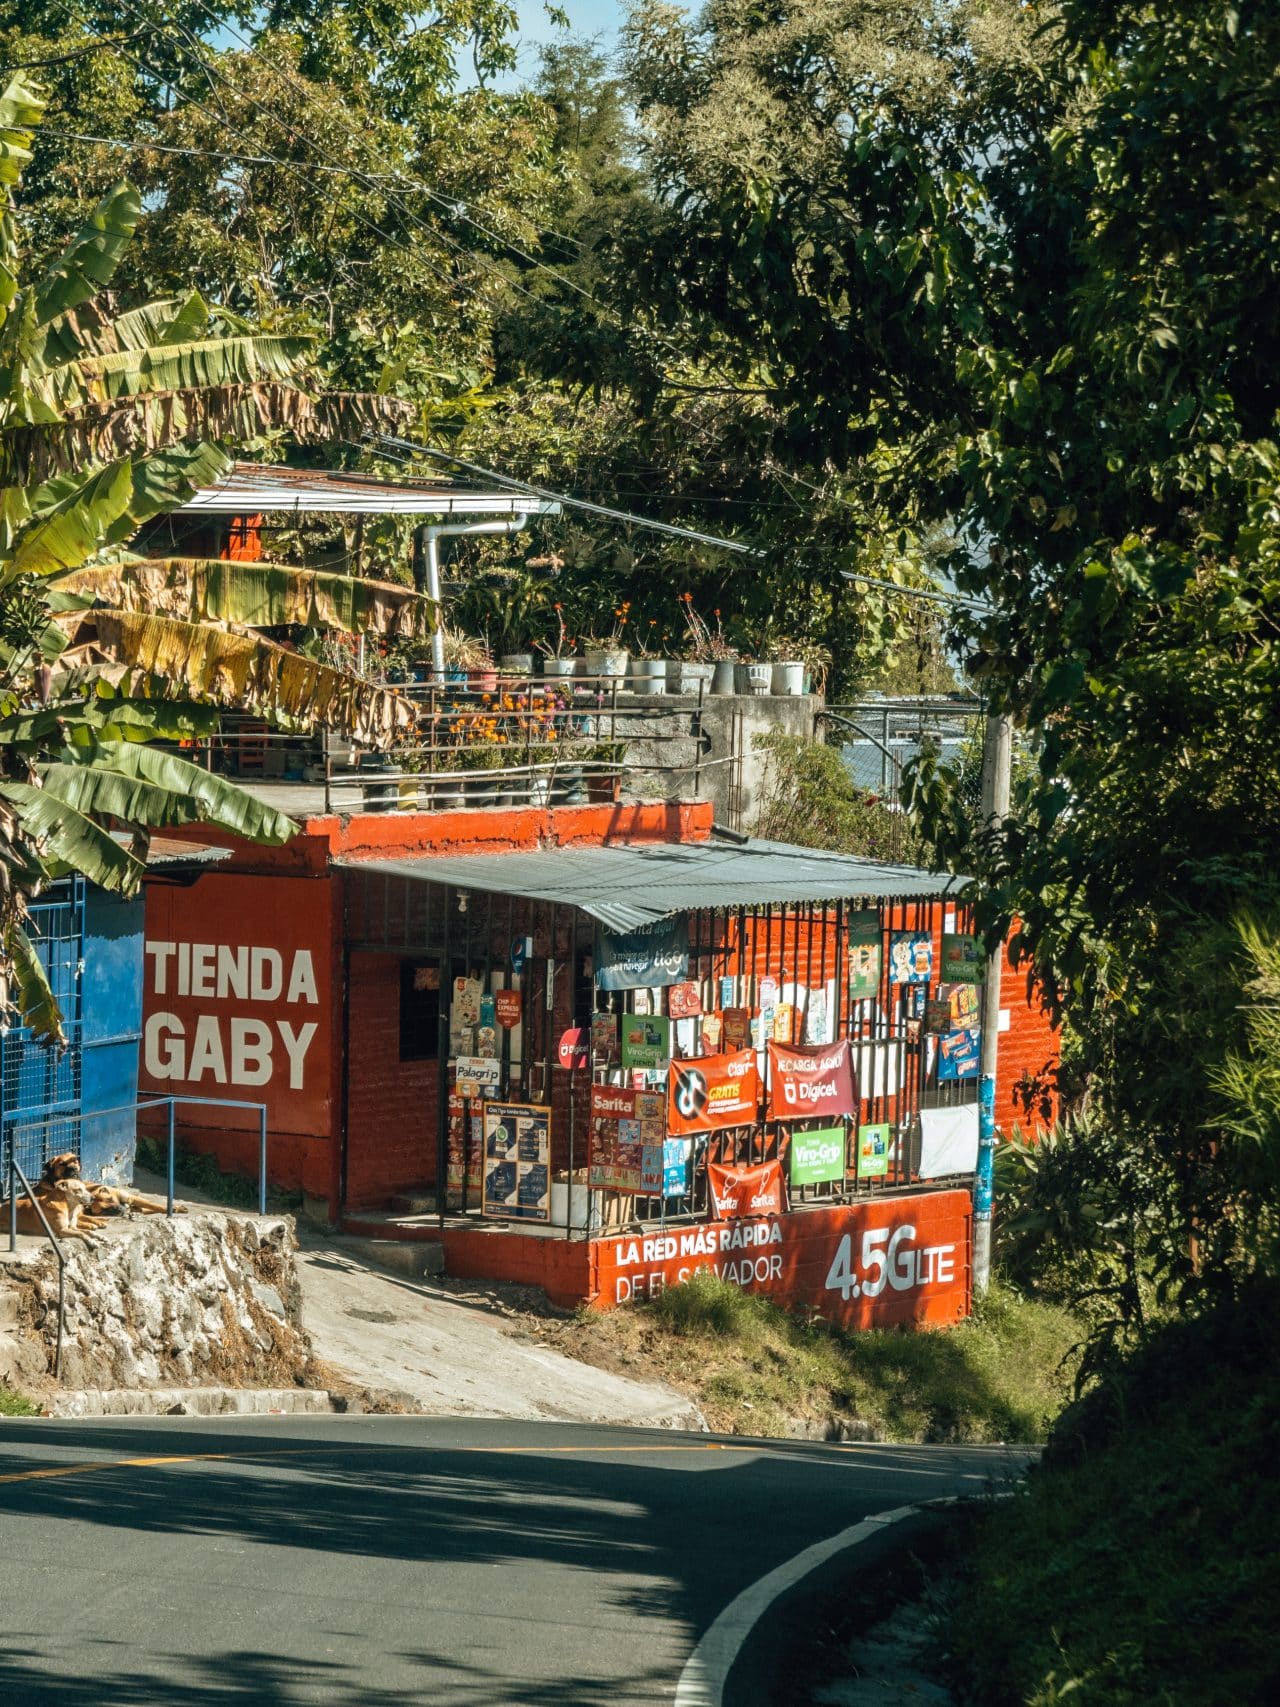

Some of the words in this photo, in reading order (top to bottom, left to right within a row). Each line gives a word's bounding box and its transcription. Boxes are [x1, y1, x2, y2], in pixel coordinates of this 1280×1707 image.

[145, 940, 319, 1005] TIENDA
[951, 975, 975, 983] TIENDA
[497, 1004, 519, 1012] EXPRESS
[144, 1011, 319, 1090] GABY
[709, 1083, 741, 1102] GRATIS
[799, 1080, 838, 1103] Digicel
[593, 1095, 632, 1113] Sarita
[795, 1141, 842, 1162] Viro-Grip
[751, 1194, 776, 1208] Sarita
[616, 1242, 640, 1267] LA
[643, 1236, 678, 1263] RED
[680, 1226, 717, 1257] MÁS
[720, 1222, 783, 1252] RÁPIDA
[616, 1274, 645, 1304] DE
